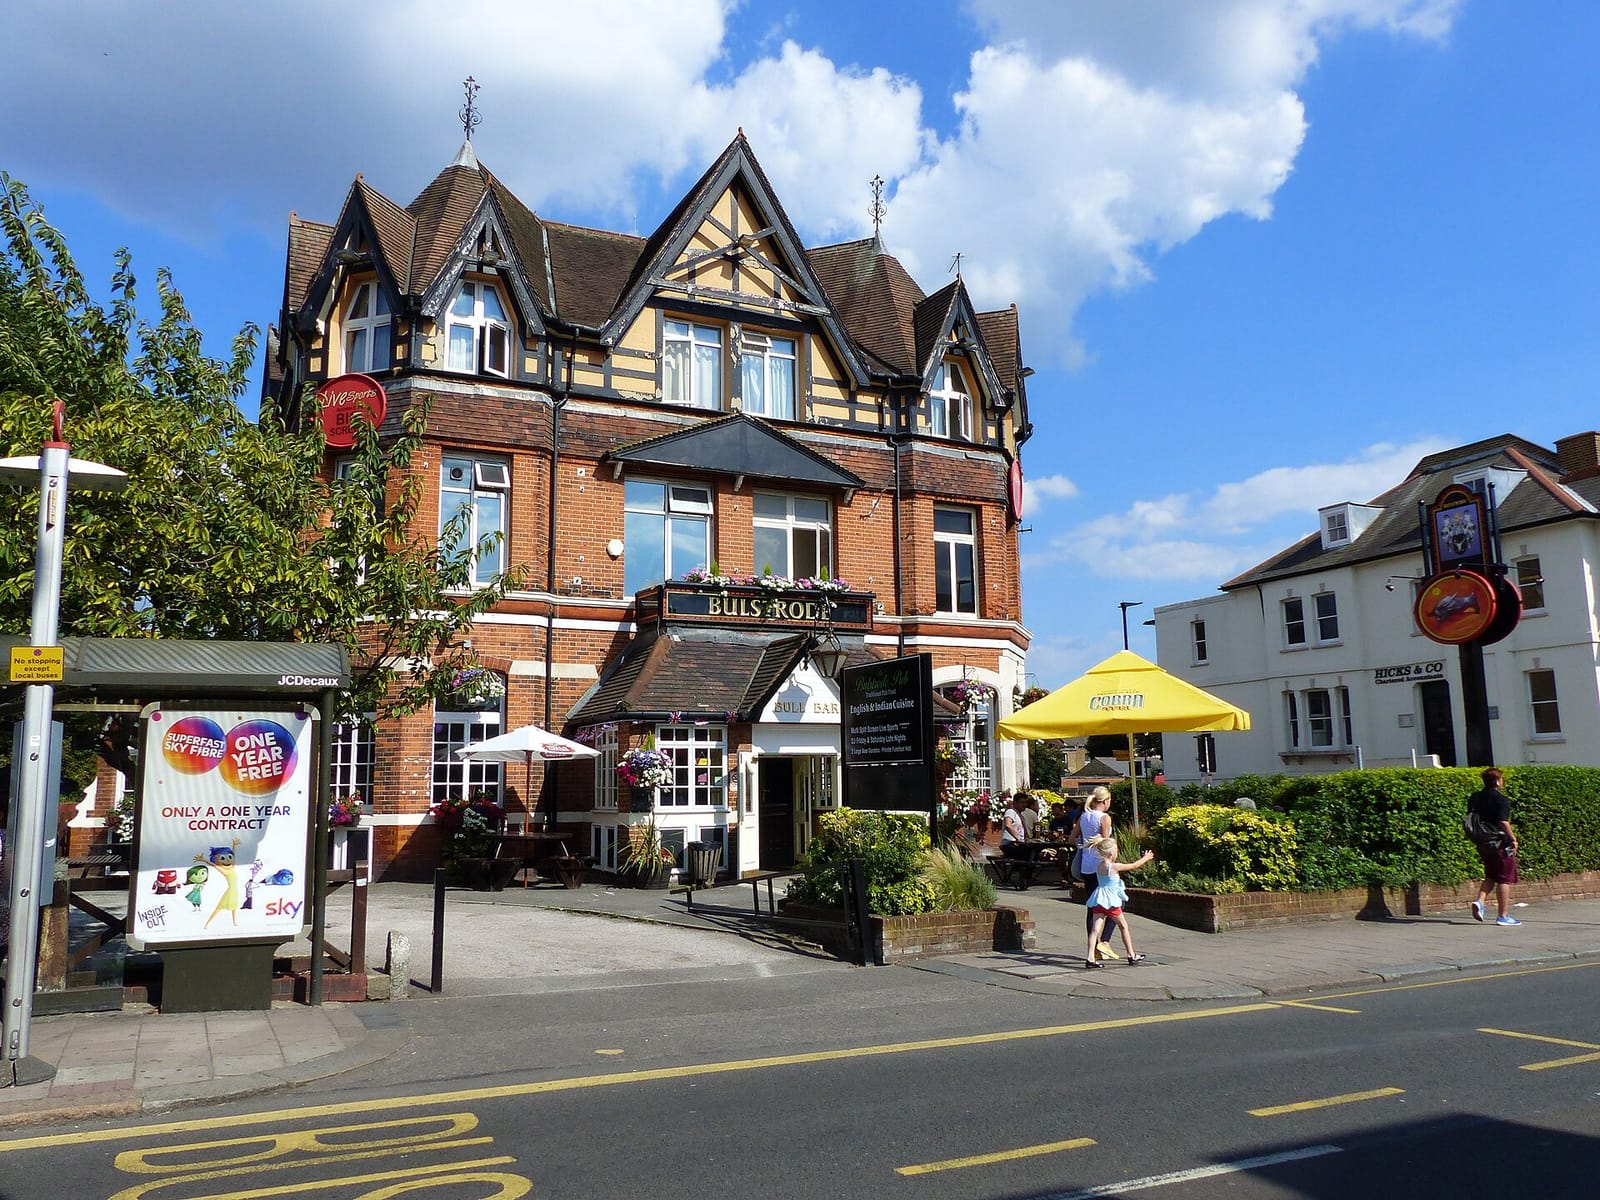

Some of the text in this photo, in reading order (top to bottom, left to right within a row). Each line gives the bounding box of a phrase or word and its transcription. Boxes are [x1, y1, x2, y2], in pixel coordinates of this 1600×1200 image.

[319, 390, 347, 408] Live
[1375, 663, 1443, 678] HICKS & CO
[278, 675, 339, 686] JCDecaux
[774, 702, 839, 714] BULL BAR
[850, 698, 914, 716] English & Indian Cuisine
[1090, 695, 1143, 710] COBRA
[166, 732, 225, 749] SUPERFAST
[234, 732, 277, 751] ONE
[164, 741, 224, 759] SKY FIBRE
[231, 746, 284, 767] YEAR
[237, 761, 283, 782] FREE
[161, 806, 290, 818] ONLY A ONE YEAR
[188, 819, 265, 830] CONTRACT
[265, 897, 303, 919] sky
[146, 915, 166, 929] OUT
